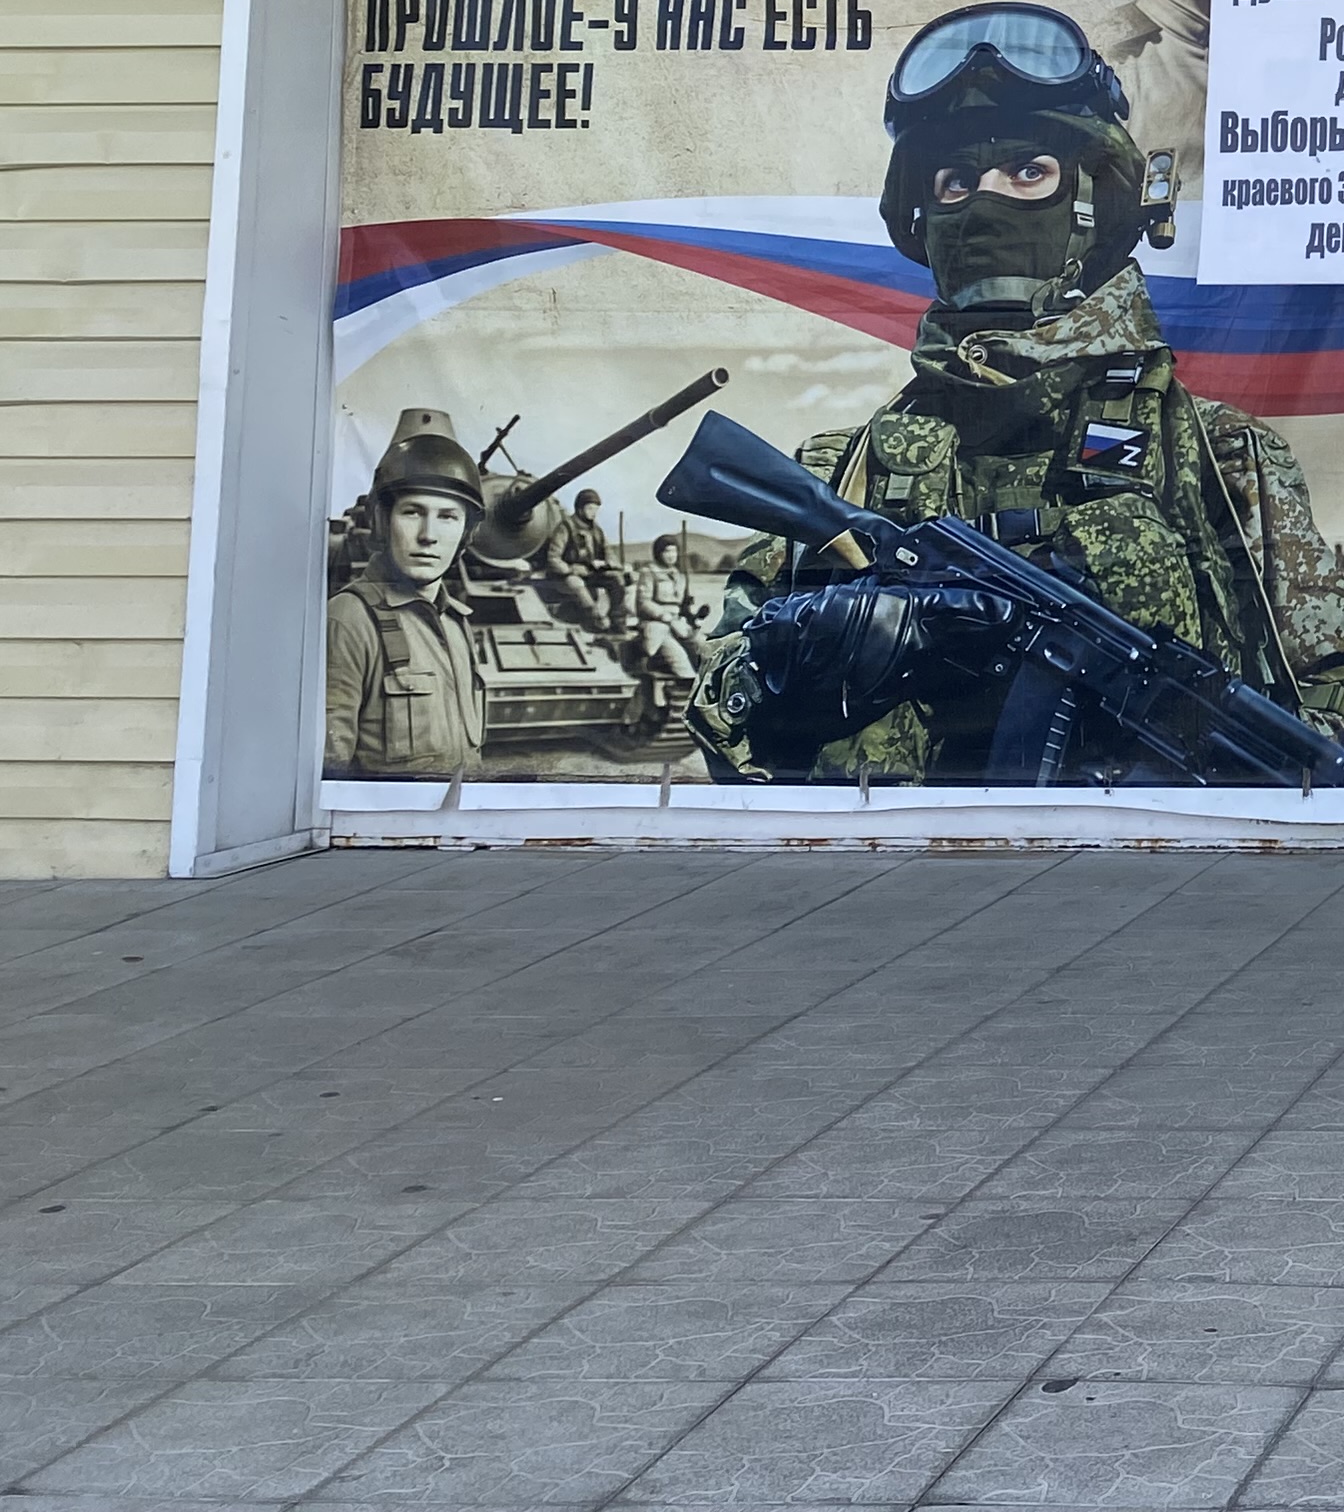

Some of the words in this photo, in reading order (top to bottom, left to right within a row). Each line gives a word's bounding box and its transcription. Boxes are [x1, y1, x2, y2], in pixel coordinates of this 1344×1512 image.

[360, 61, 594, 134] БУДУЩЕЕ!
[1222, 175, 1332, 209] краевого
[1118, 445, 1141, 466] Z
